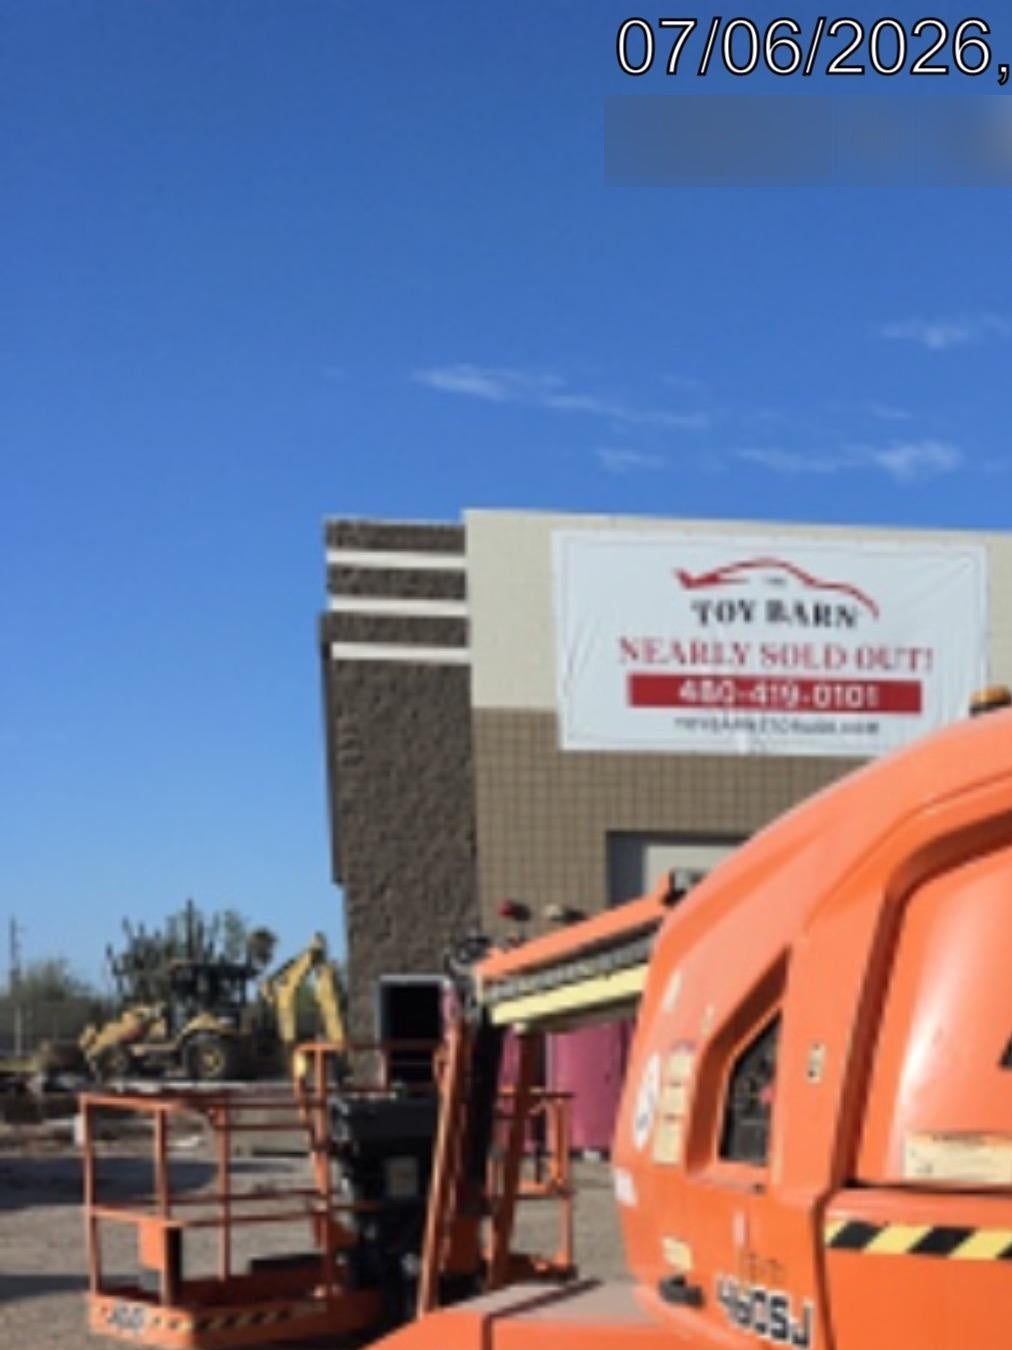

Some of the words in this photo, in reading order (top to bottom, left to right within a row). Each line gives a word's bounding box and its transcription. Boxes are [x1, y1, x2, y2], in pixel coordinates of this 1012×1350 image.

[691, 598, 755, 627] TOY
[765, 600, 858, 629] BARN
[618, 636, 752, 667] NEARLY
[760, 641, 848, 669] SOLD
[855, 645, 934, 673] OUT!
